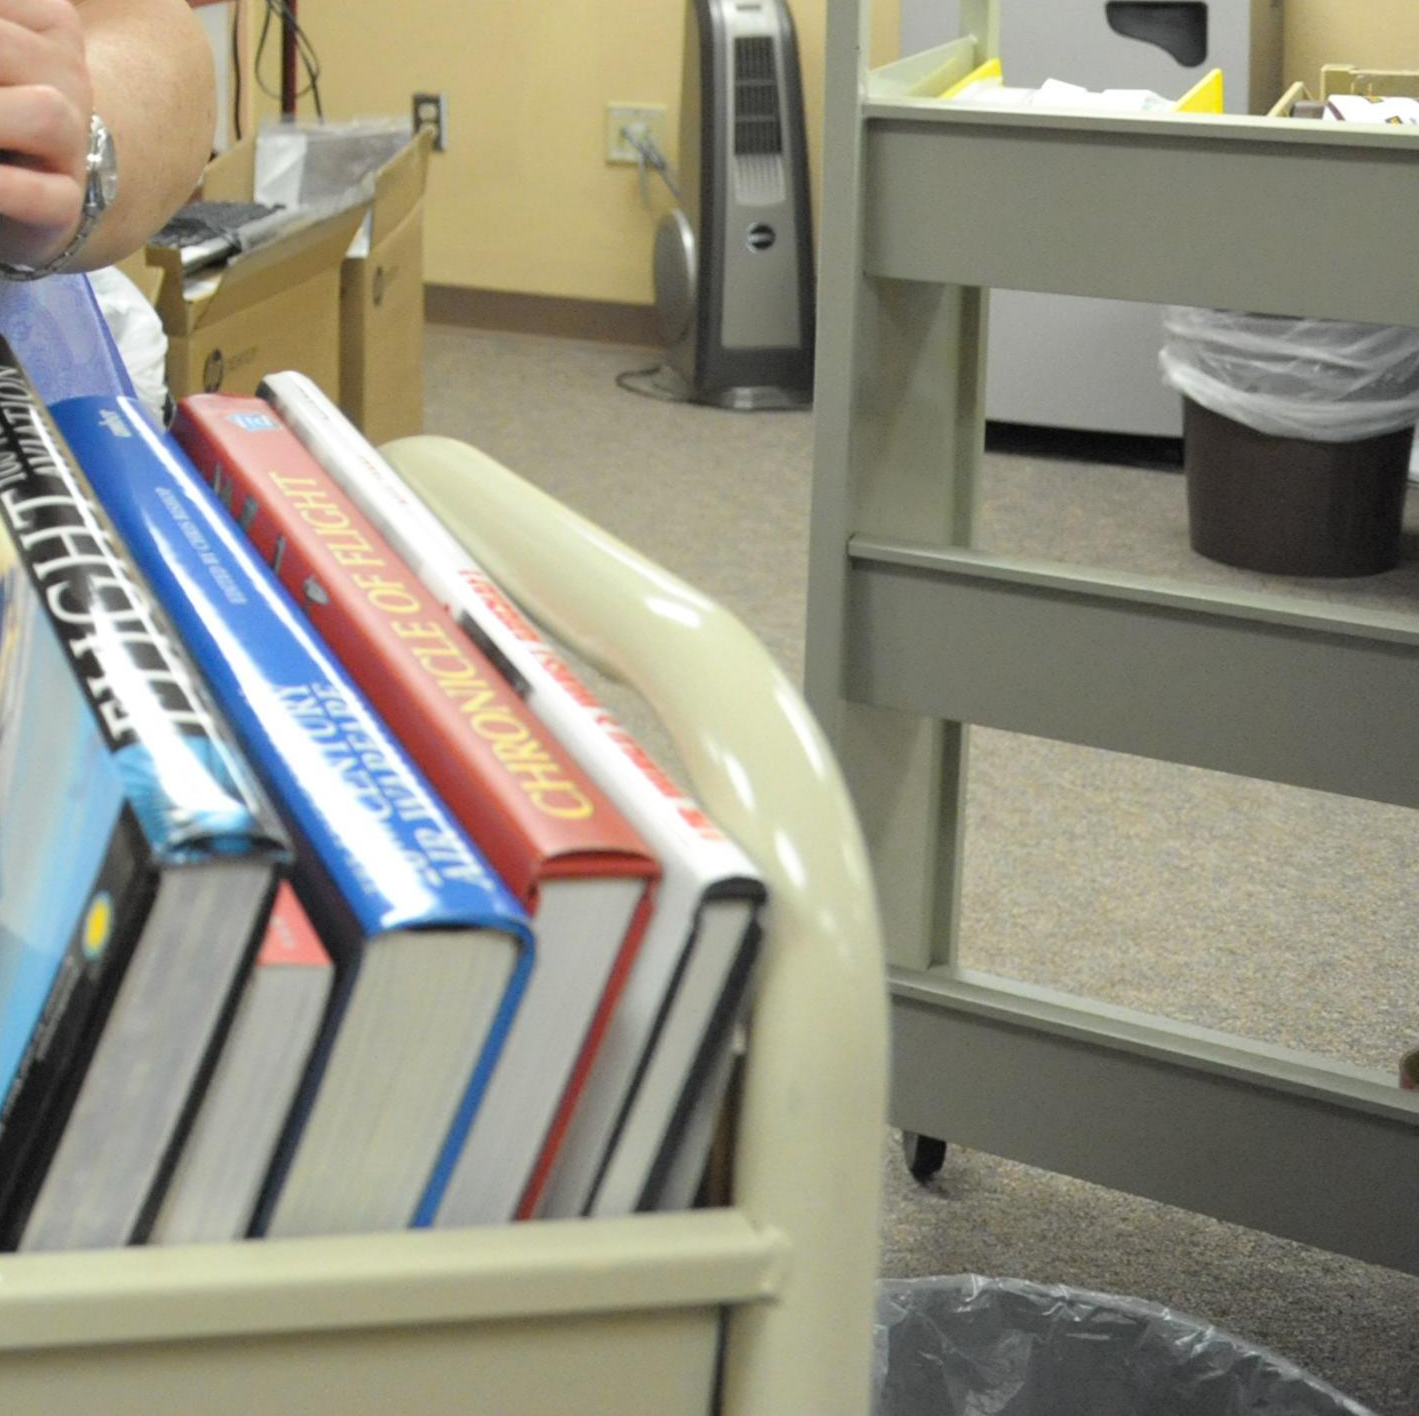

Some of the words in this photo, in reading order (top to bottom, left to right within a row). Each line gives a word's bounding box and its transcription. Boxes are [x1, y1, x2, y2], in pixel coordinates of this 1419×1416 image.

[154, 481, 189, 526] BISHOP
[178, 517, 210, 555] CHRIS
[270, 471, 386, 578] FLIGHT
[1, 488, 212, 742] FLIGHT
[207, 560, 248, 609] EDITED
[354, 566, 420, 628] OF
[272, 682, 393, 824] CENTURY
[312, 681, 427, 814] WARFARE
[392, 621, 595, 822] CHRONICLE
[416, 811, 495, 892] AIR
